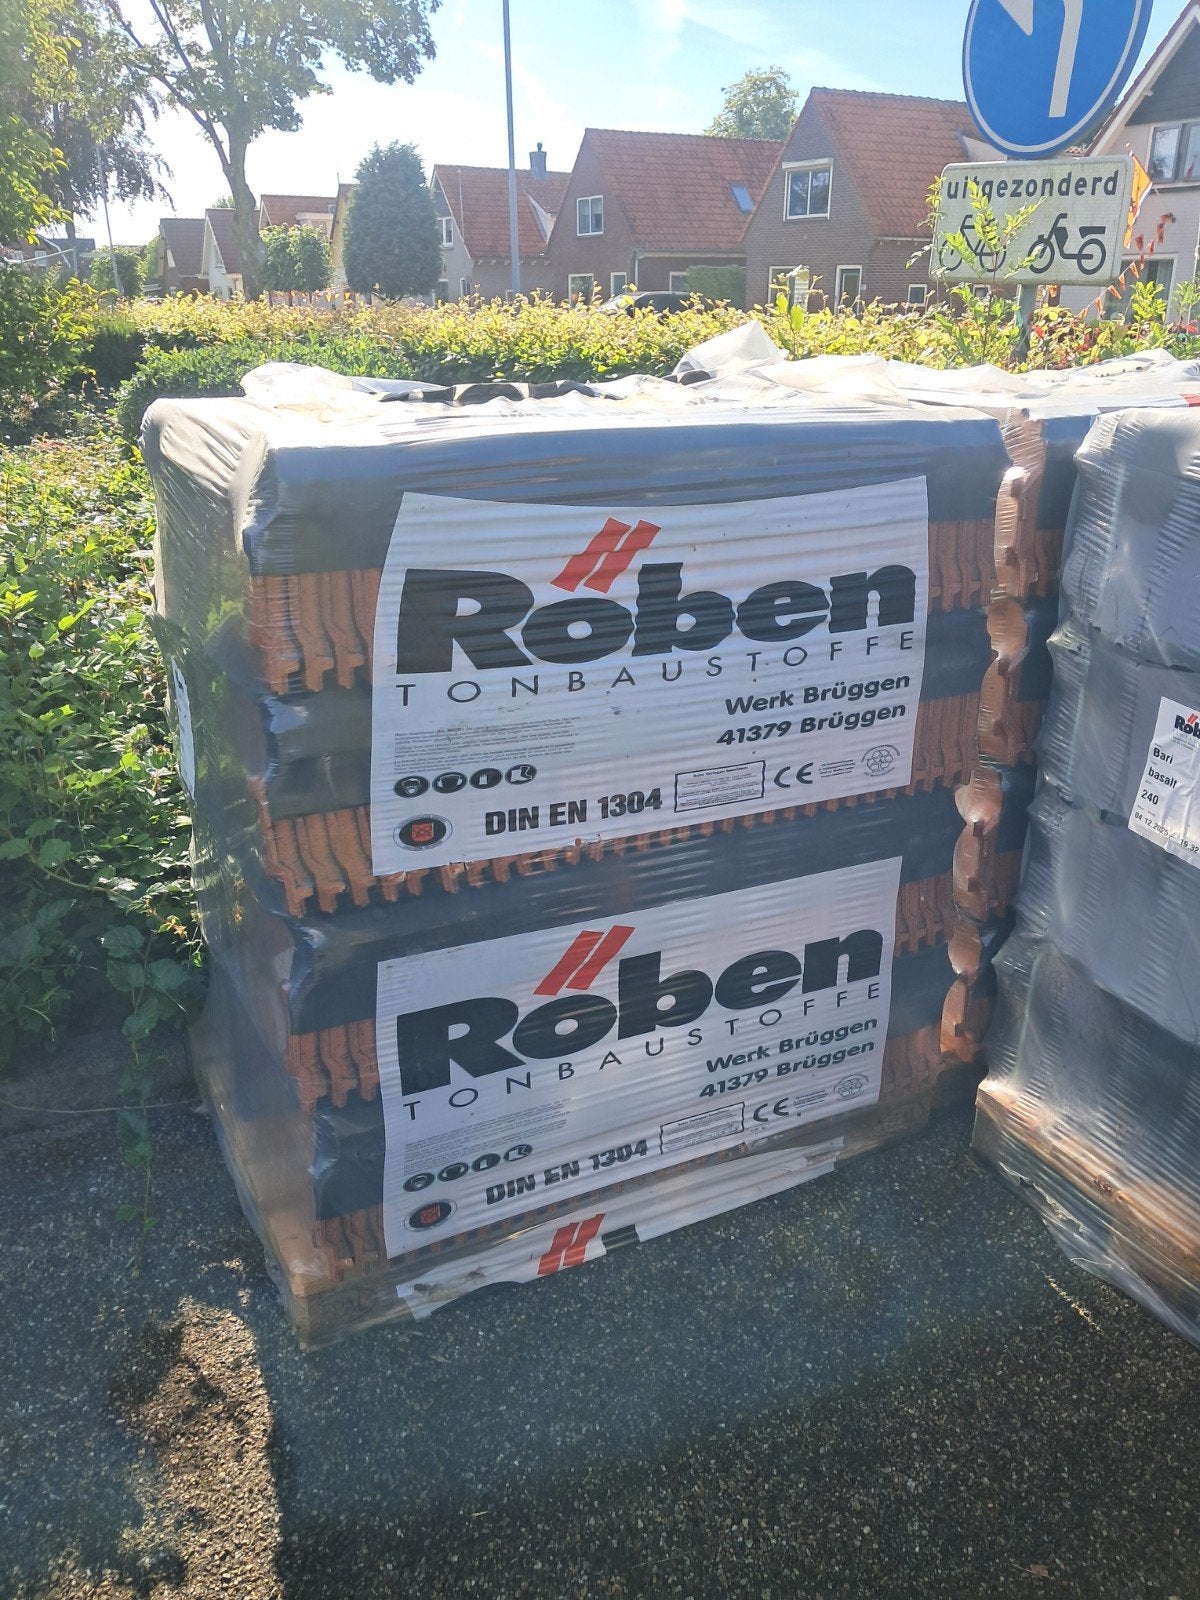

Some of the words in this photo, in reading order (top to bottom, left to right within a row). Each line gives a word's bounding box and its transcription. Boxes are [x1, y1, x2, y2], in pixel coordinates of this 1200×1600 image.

[396, 517, 917, 675] Röben
[396, 630, 915, 707] TONBAUSTOFFE
[725, 690, 794, 716] Werk
[803, 675, 910, 704] Brüggen
[716, 720, 792, 746] 41379
[800, 704, 906, 734] Brüggen
[1148, 766, 1178, 789] basalt
[1153, 747, 1174, 765] Bari
[485, 804, 540, 837] DIN
[549, 797, 588, 827] EN
[598, 788, 663, 819] 1304
[1141, 789, 1159, 805] 240
[397, 925, 884, 1097] Röben
[403, 983, 881, 1121] TONBAUSTOFFE
[699, 1068, 769, 1097] 41379
[776, 1041, 875, 1077] Brüggen
[706, 1046, 771, 1073] Werk
[779, 1018, 878, 1053] Brüggen
[485, 1174, 536, 1206] DIN
[544, 1160, 581, 1187] EN
[591, 1140, 648, 1175] 1304
